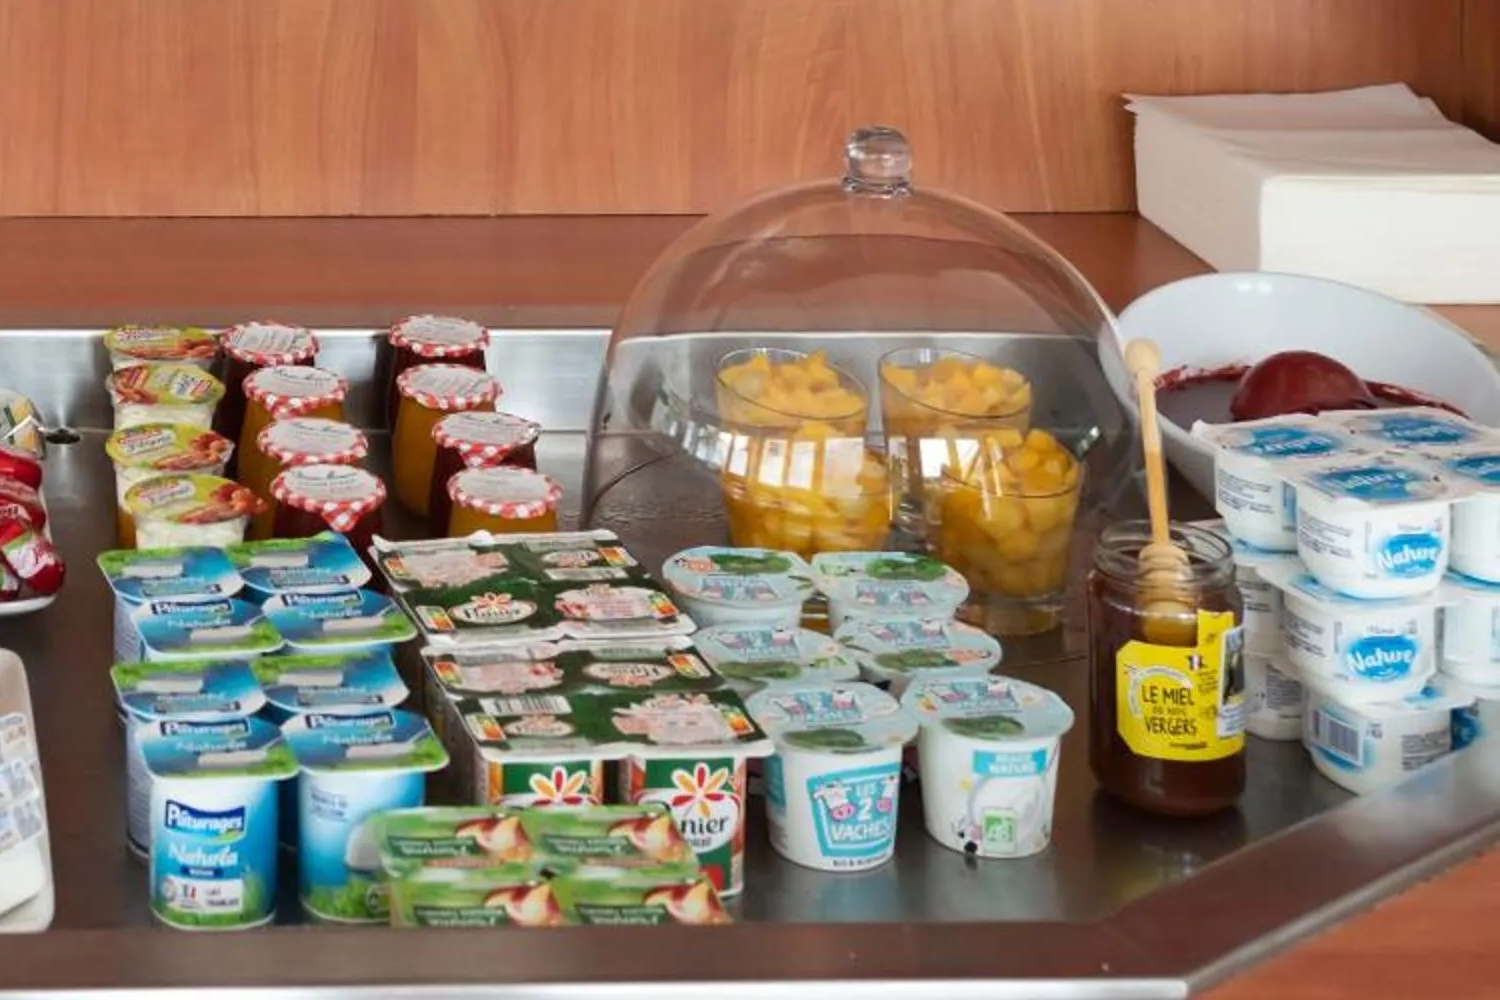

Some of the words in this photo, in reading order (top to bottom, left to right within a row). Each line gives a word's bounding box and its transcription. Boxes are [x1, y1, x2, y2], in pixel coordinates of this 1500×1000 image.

[1376, 544, 1438, 569] Nature
[1348, 647, 1414, 673] Nature
[1141, 684, 1159, 704] LE
[1163, 687, 1196, 706] MIEL
[1145, 716, 1198, 737] VERGERS
[859, 798, 872, 821] 2
[681, 816, 729, 835] nier
